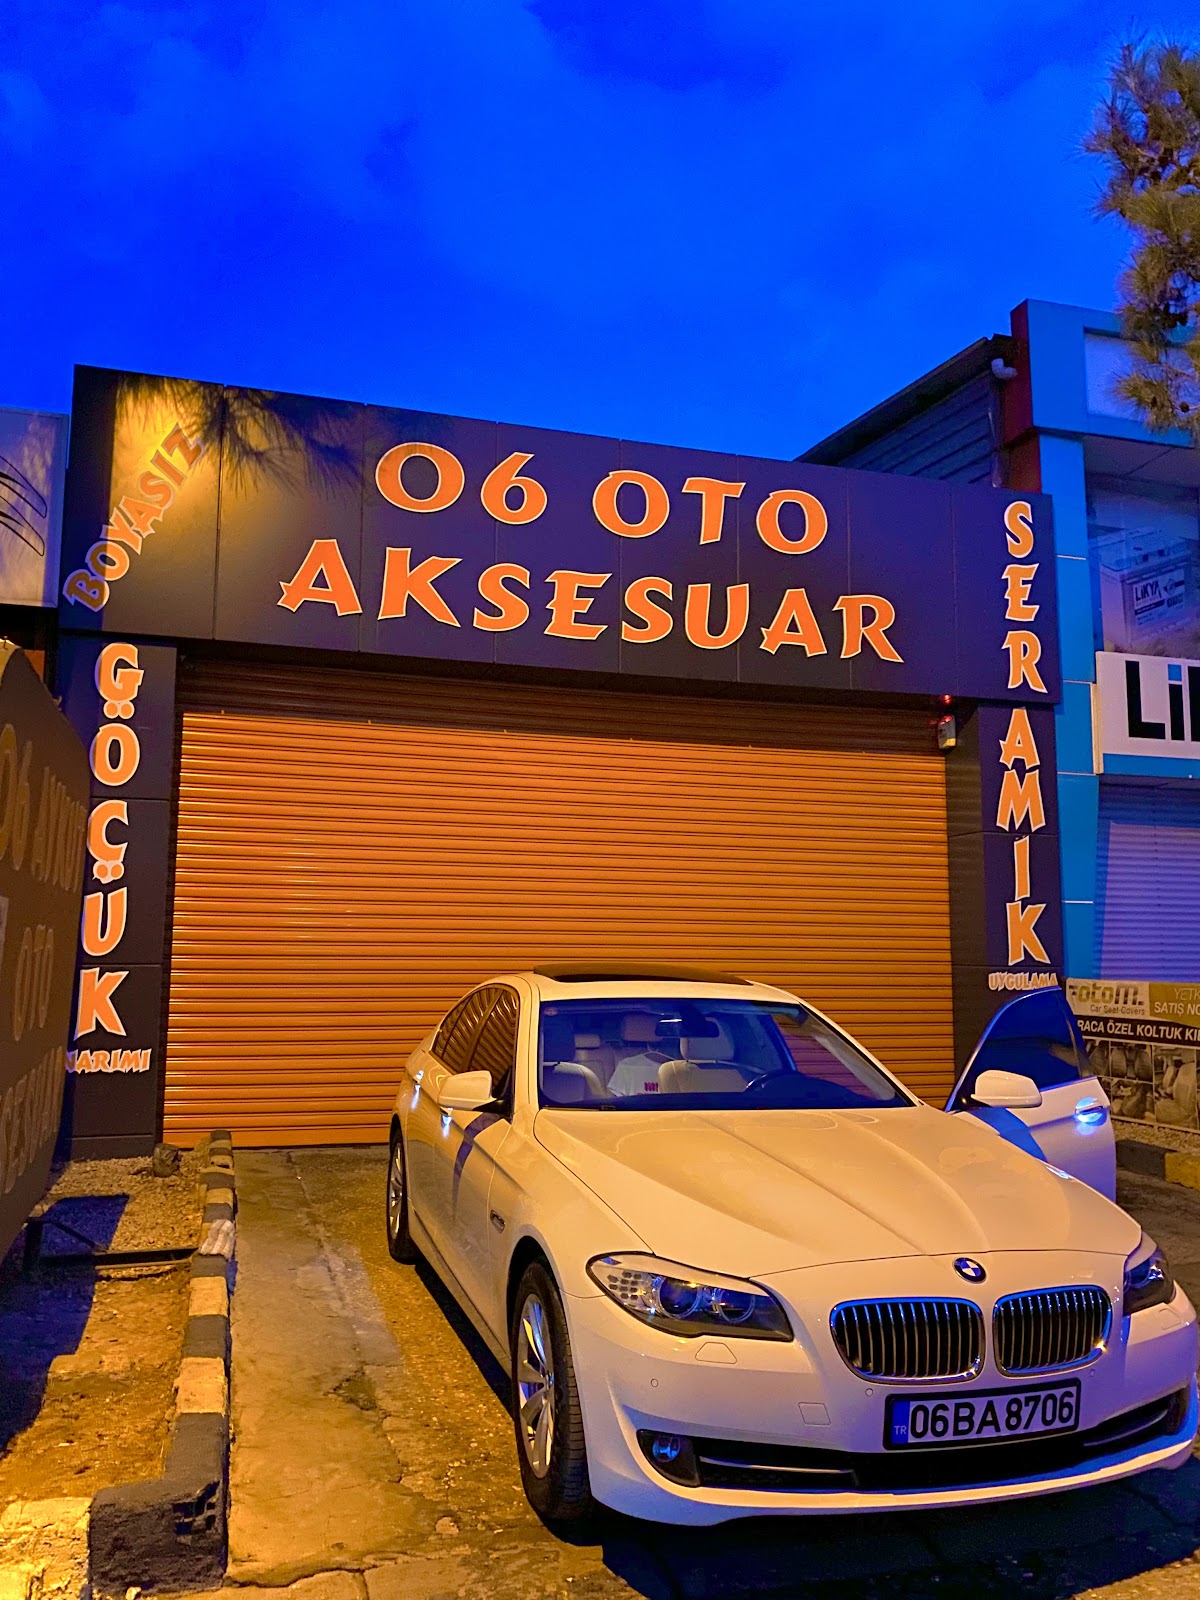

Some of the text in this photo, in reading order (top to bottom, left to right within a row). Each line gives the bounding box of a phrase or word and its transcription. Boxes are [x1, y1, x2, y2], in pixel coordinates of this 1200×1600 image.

[63, 422, 203, 612] BOYASIZ
[592, 469, 829, 556] OTO
[277, 538, 905, 664] AKSESUAR
[988, 971, 1059, 992] UYGULAMA
[1154, 1001, 1185, 1018] SATIŞ
[1077, 1019, 1105, 1034] RACA
[1106, 1019, 1134, 1036] ÖZEL
[1136, 1024, 1183, 1040] KOLTUK
[65, 1048, 152, 1074] NARIMI
[894, 1425, 907, 1435] TR
